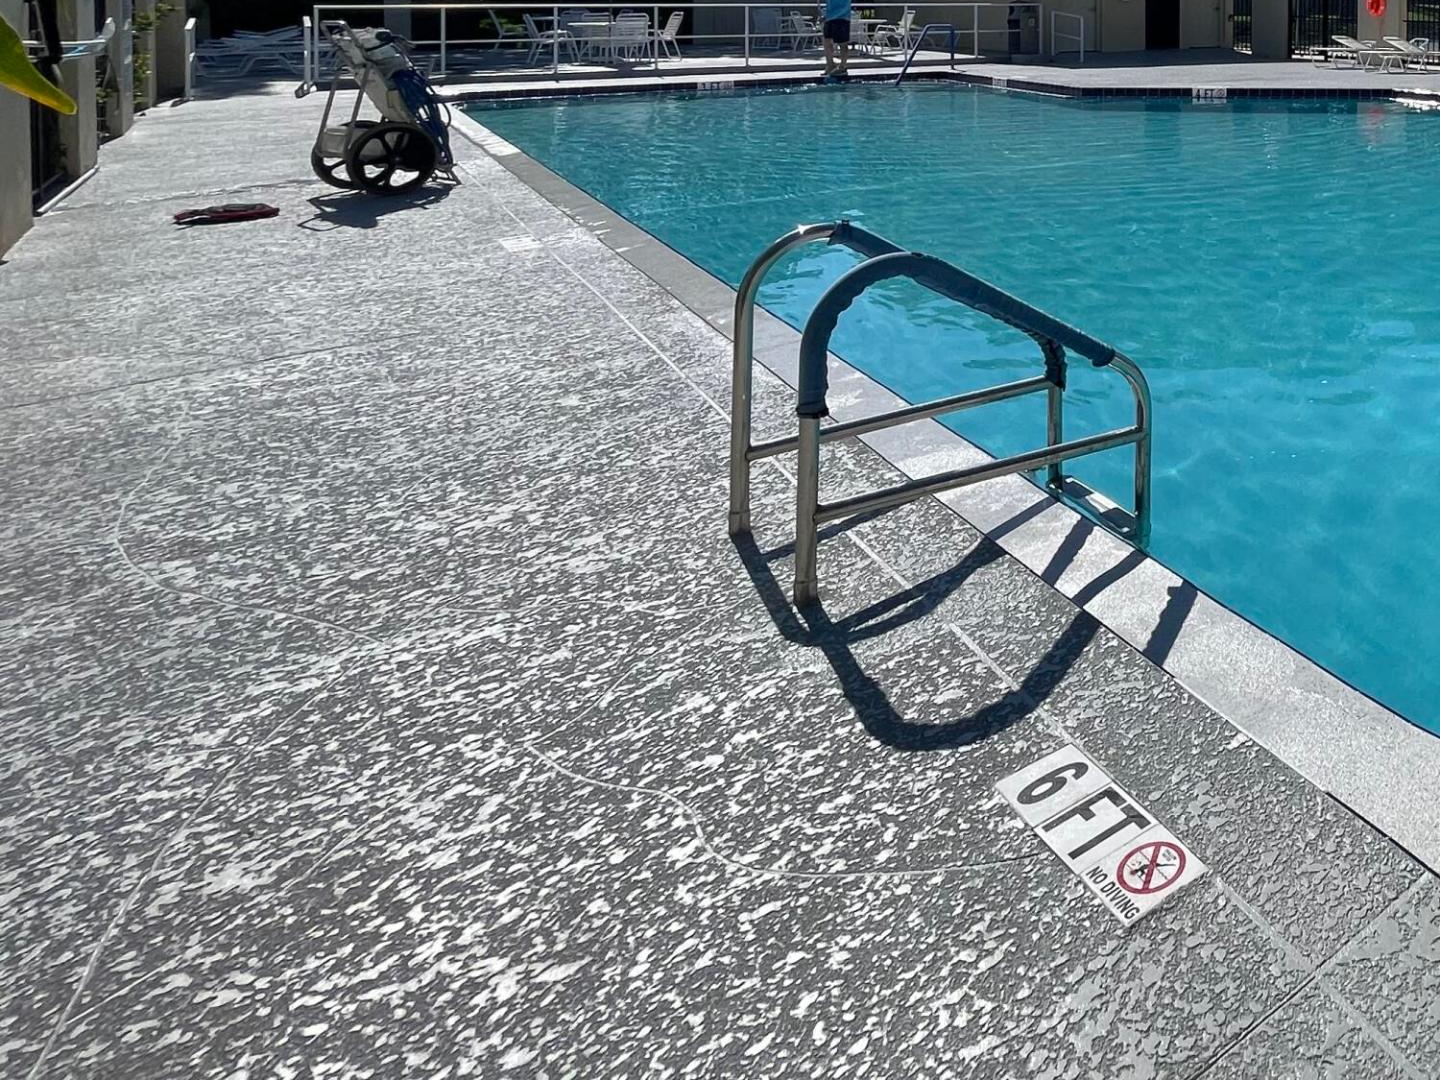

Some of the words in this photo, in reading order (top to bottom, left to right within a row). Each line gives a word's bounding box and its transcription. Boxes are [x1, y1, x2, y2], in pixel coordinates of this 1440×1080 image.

[1204, 88, 1216, 98] FT
[1016, 761, 1089, 805] 6
[1041, 786, 1152, 860] FT
[1086, 866, 1102, 885] NO
[1100, 881, 1141, 920] DIVING
